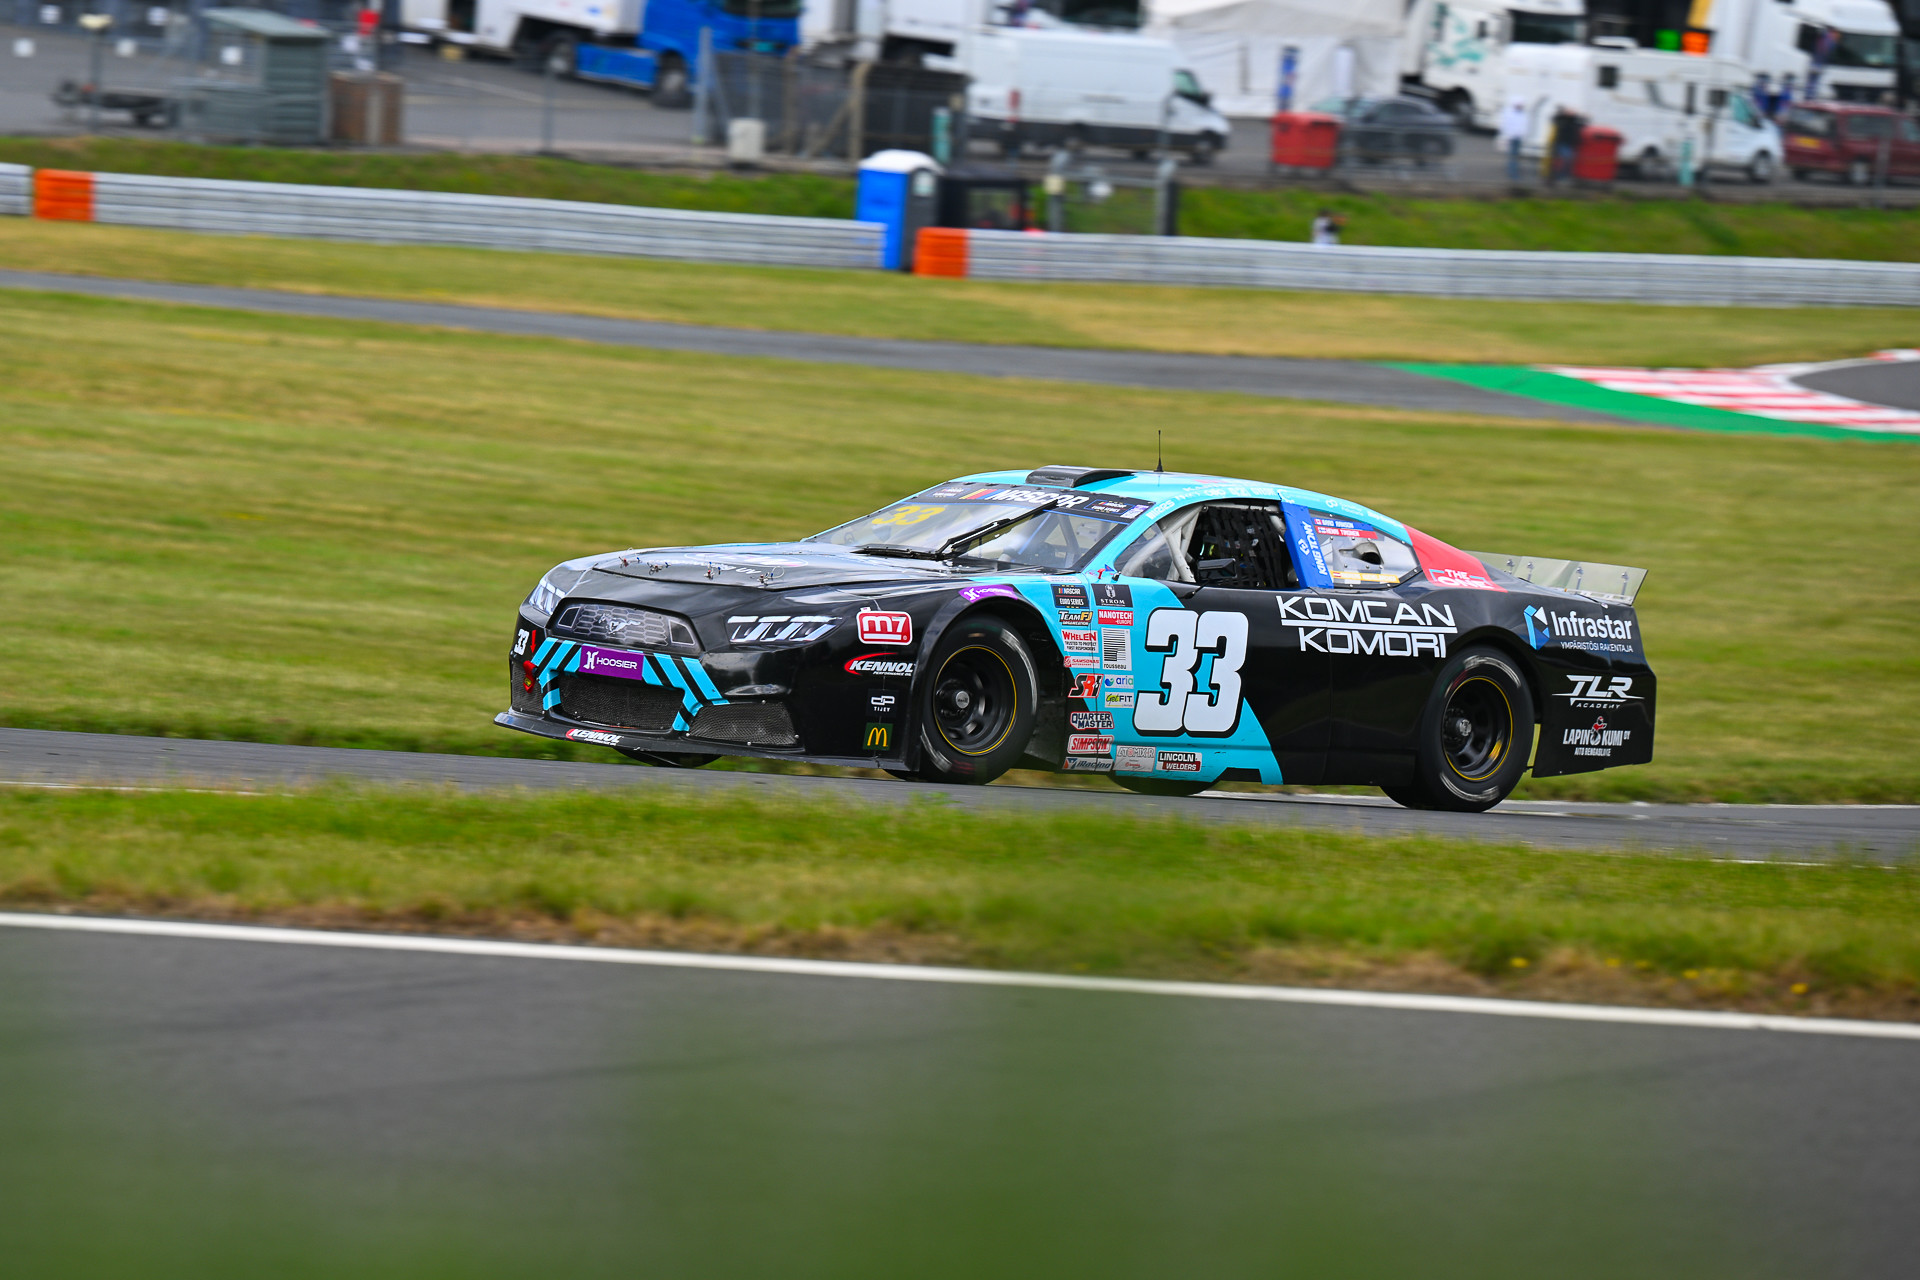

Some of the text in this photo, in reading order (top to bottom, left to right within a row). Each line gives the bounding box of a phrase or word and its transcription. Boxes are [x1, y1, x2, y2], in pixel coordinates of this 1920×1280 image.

[984, 489, 1089, 508] NASCAR
[872, 506, 945, 525] 33
[1302, 521, 1318, 550] TONY
[1312, 550, 1328, 575] KING
[1444, 569, 1470, 579] THE
[1438, 576, 1494, 589] ONE
[1099, 611, 1132, 620] NANOTECH
[1275, 595, 1456, 627] KOMCAN
[1550, 611, 1632, 639] Infrastar
[514, 629, 530, 656] 33
[1062, 631, 1096, 641] WHELEN
[1298, 627, 1447, 658] KOMORI
[1600, 643, 1634, 653] RAKENTAJA
[596, 657, 638, 670] HOOSIER
[849, 660, 914, 673] KENNOL
[1132, 608, 1249, 735] 33
[1116, 676, 1134, 686] aria
[1558, 675, 1640, 698] TLR
[1072, 713, 1111, 724] QUARTER
[1078, 720, 1112, 728] MASTER
[569, 729, 622, 743] KENNOL
[1563, 729, 1591, 745] LAPIN
[1601, 730, 1623, 746] KUMI
[1071, 737, 1110, 751] SIMPSON
[1160, 753, 1194, 762] LINCOLN
[1077, 760, 1111, 769] iRacing
[1166, 763, 1197, 771] WELDERS
